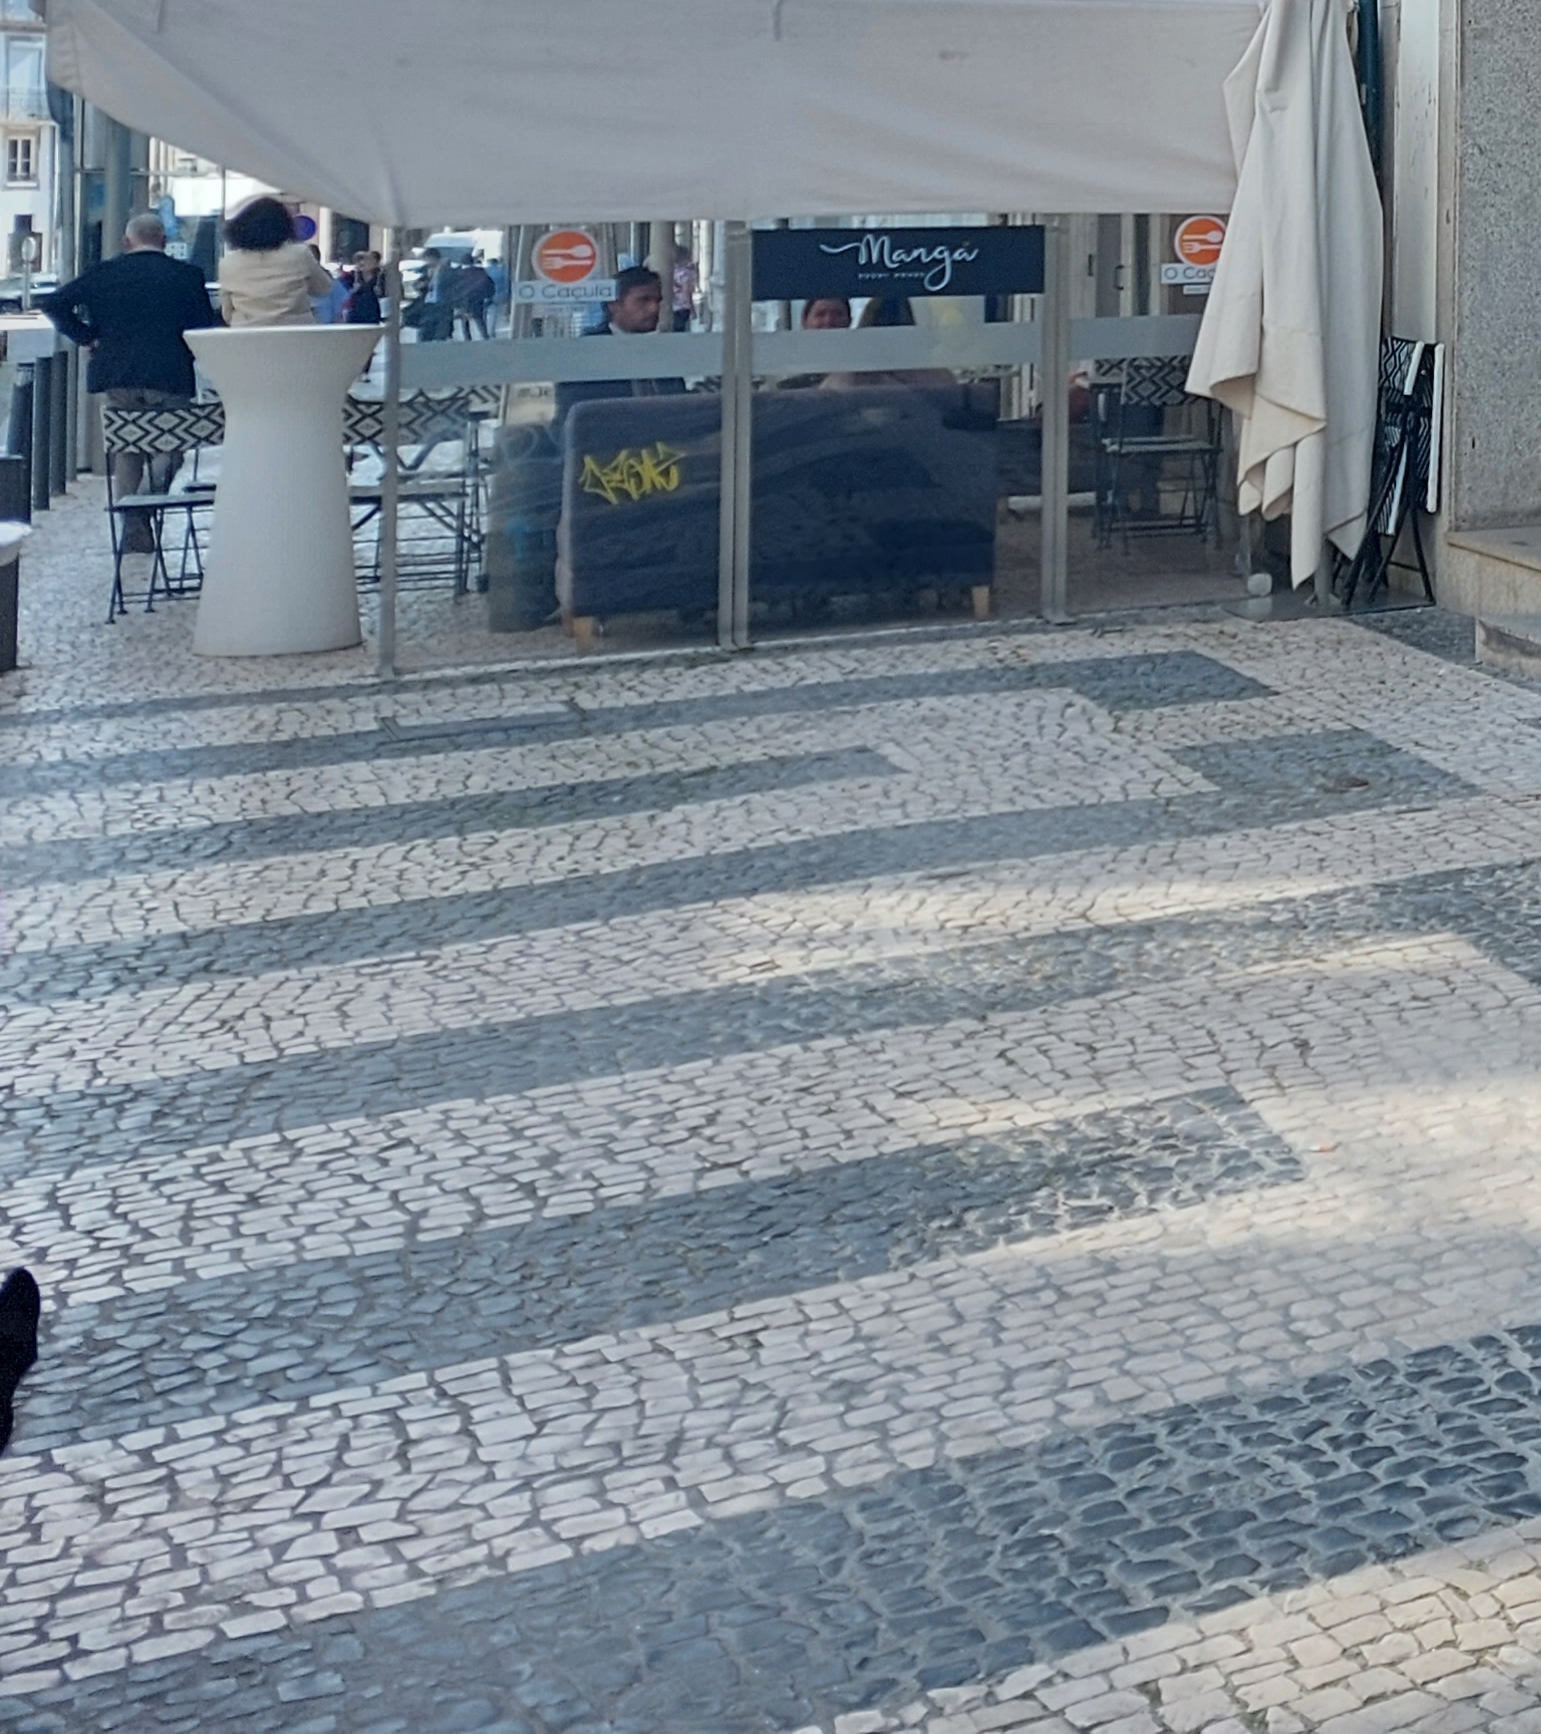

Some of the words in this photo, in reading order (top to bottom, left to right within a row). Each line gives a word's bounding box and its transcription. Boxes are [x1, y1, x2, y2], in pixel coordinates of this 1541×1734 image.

[1165, 267, 1178, 280] O
[1183, 267, 1215, 281] Caç
[518, 285, 535, 298] O
[541, 284, 612, 300] Caçula
